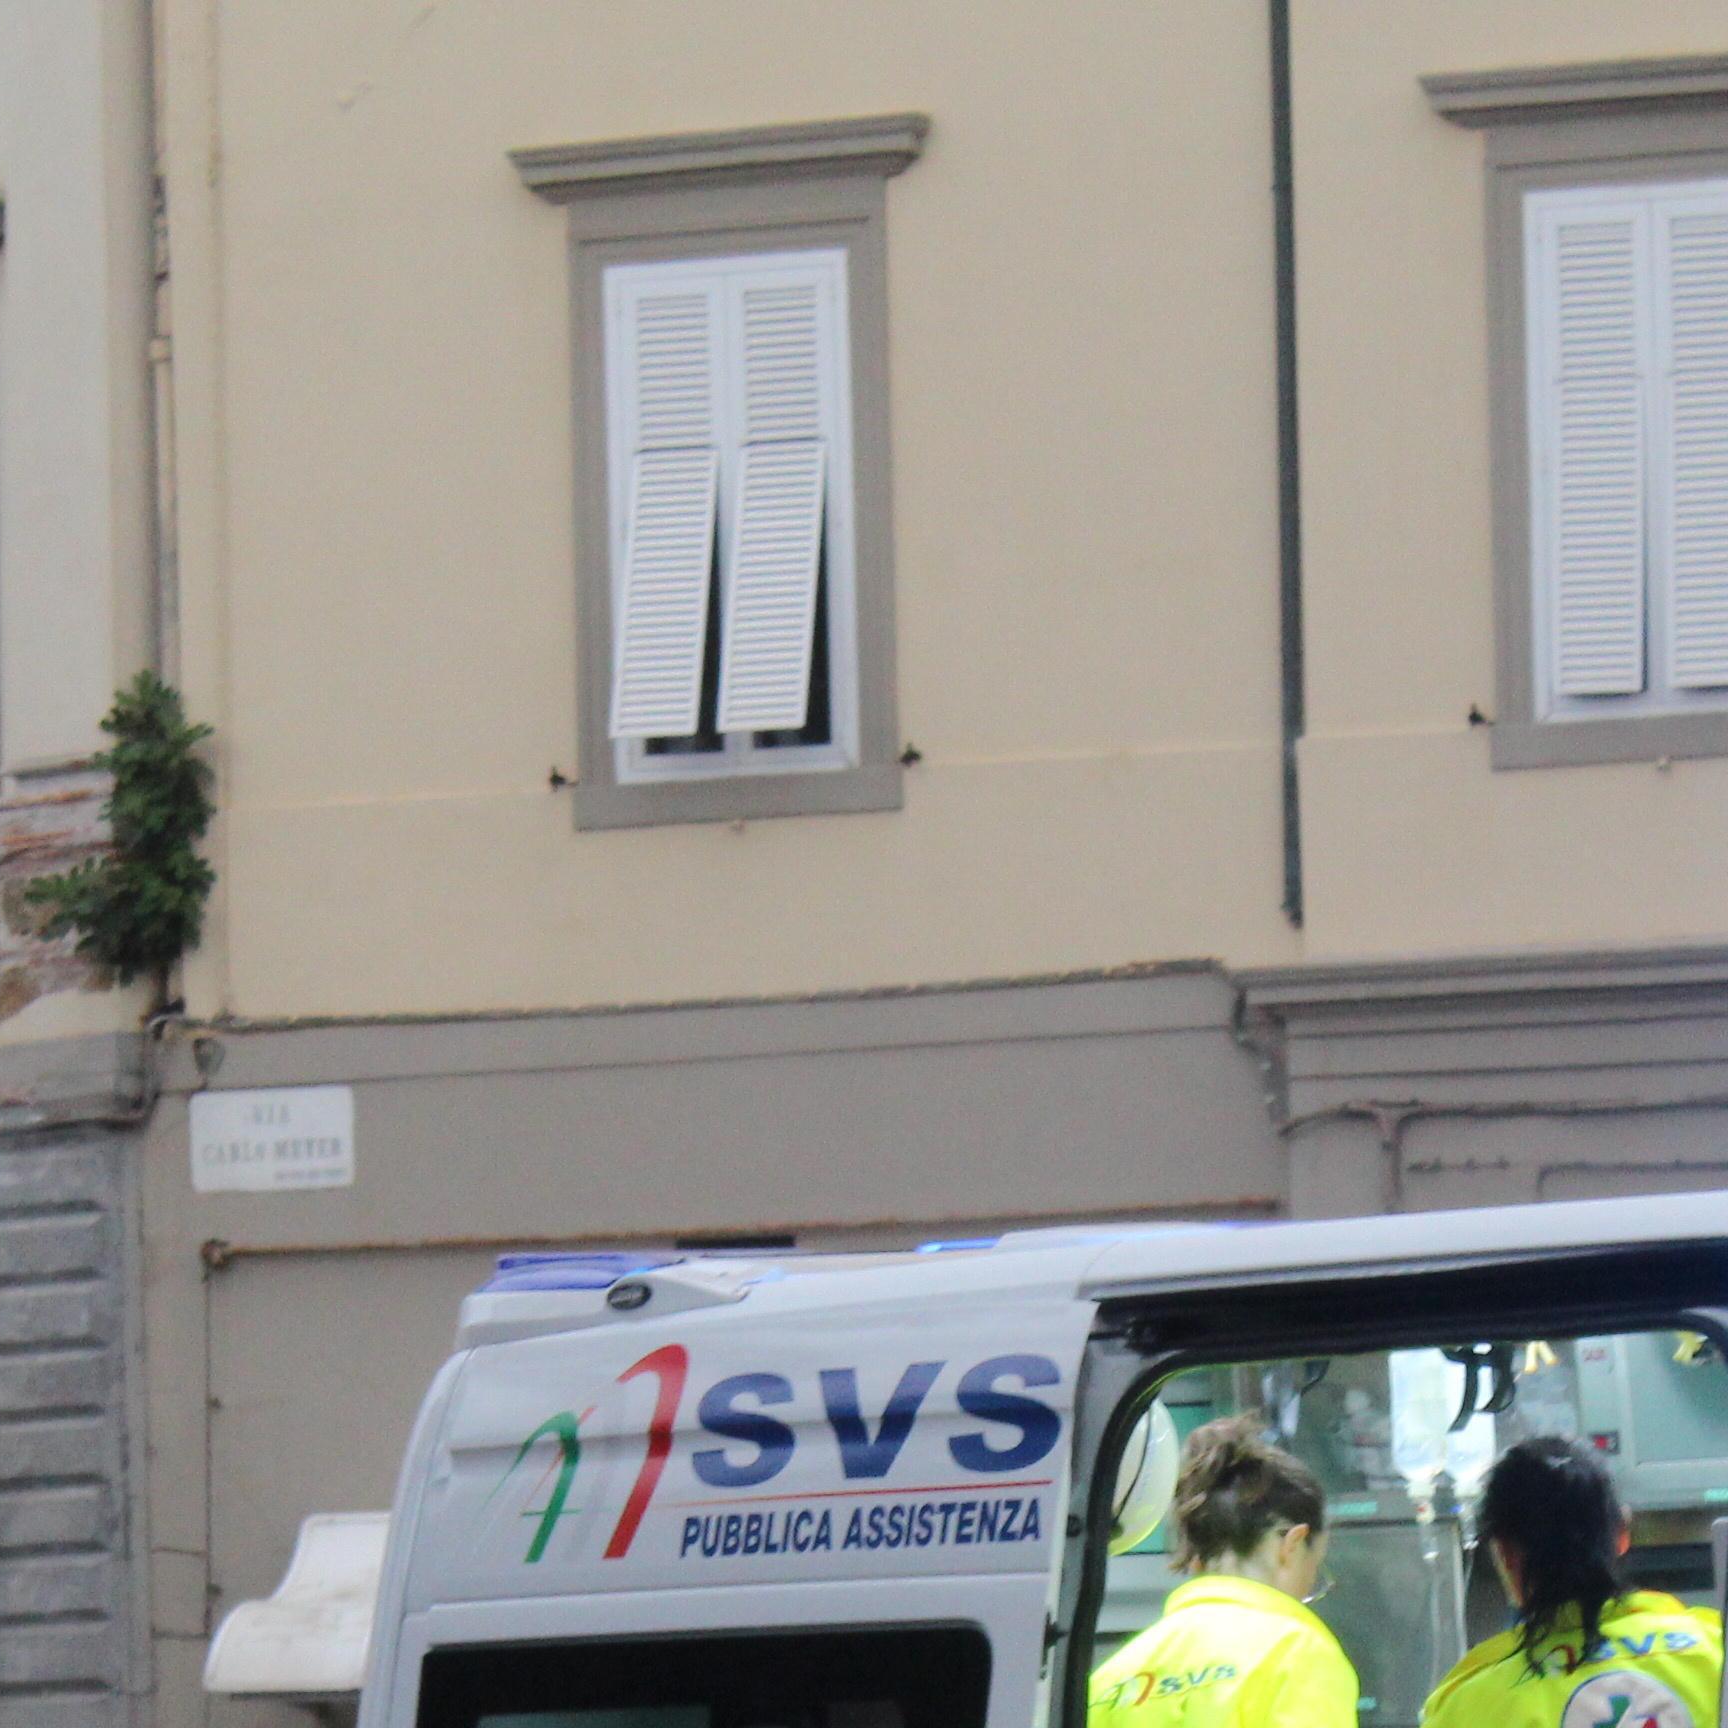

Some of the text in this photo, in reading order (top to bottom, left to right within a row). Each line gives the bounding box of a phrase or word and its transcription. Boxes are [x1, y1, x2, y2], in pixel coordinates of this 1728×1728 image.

[692, 1354, 1062, 1487] SVS
[680, 1498, 1041, 1559] PUBBLICA ASSISTENZA
[1157, 1664, 1236, 1695] SVS
